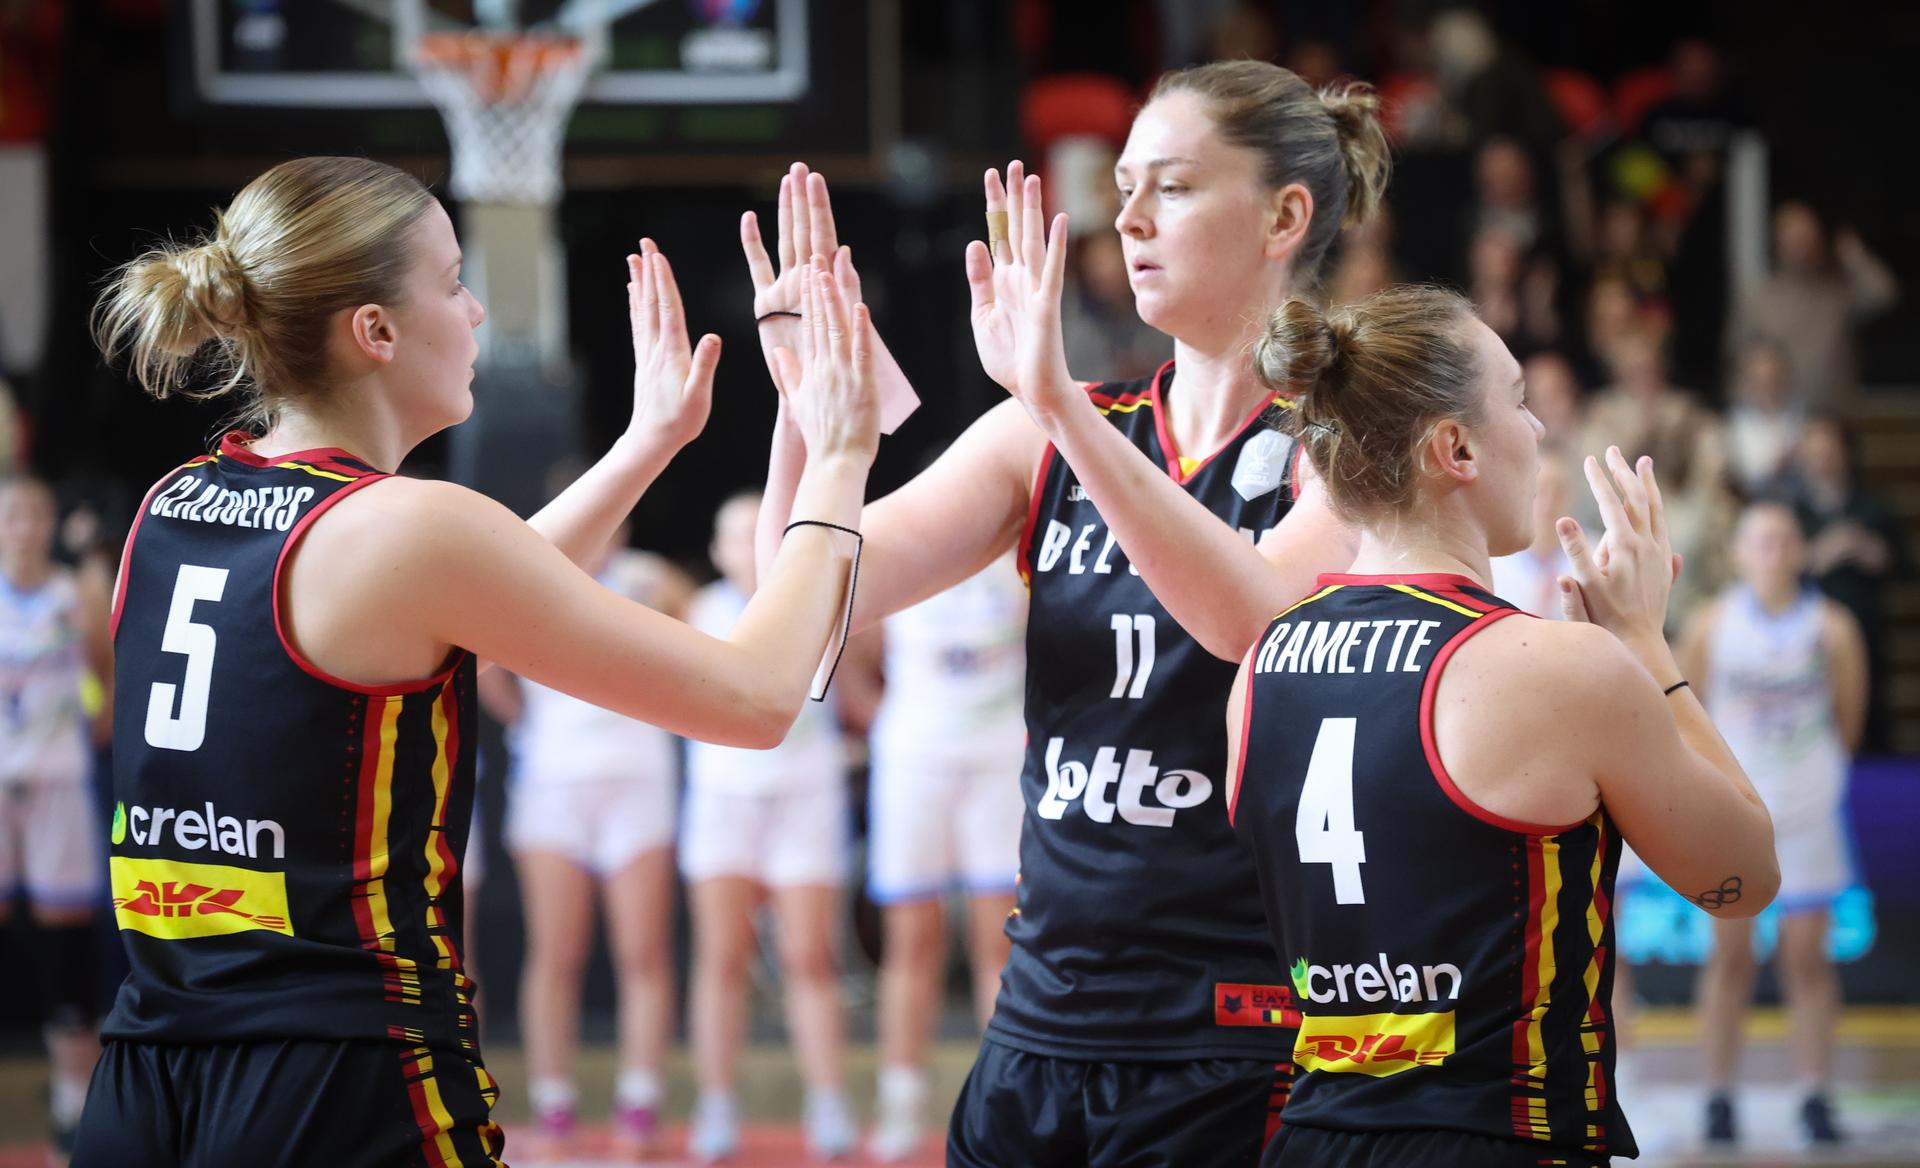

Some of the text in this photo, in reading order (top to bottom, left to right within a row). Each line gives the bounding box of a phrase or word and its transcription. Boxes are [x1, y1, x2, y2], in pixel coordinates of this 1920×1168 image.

[144, 564, 230, 752] 5
[1110, 614, 1156, 699] 11
[1255, 620, 1441, 674] RAMETTE
[130, 802, 285, 859] crelan
[1295, 717, 1366, 905] 4
[122, 879, 254, 918] DHL
[1308, 953, 1462, 1004] crelan
